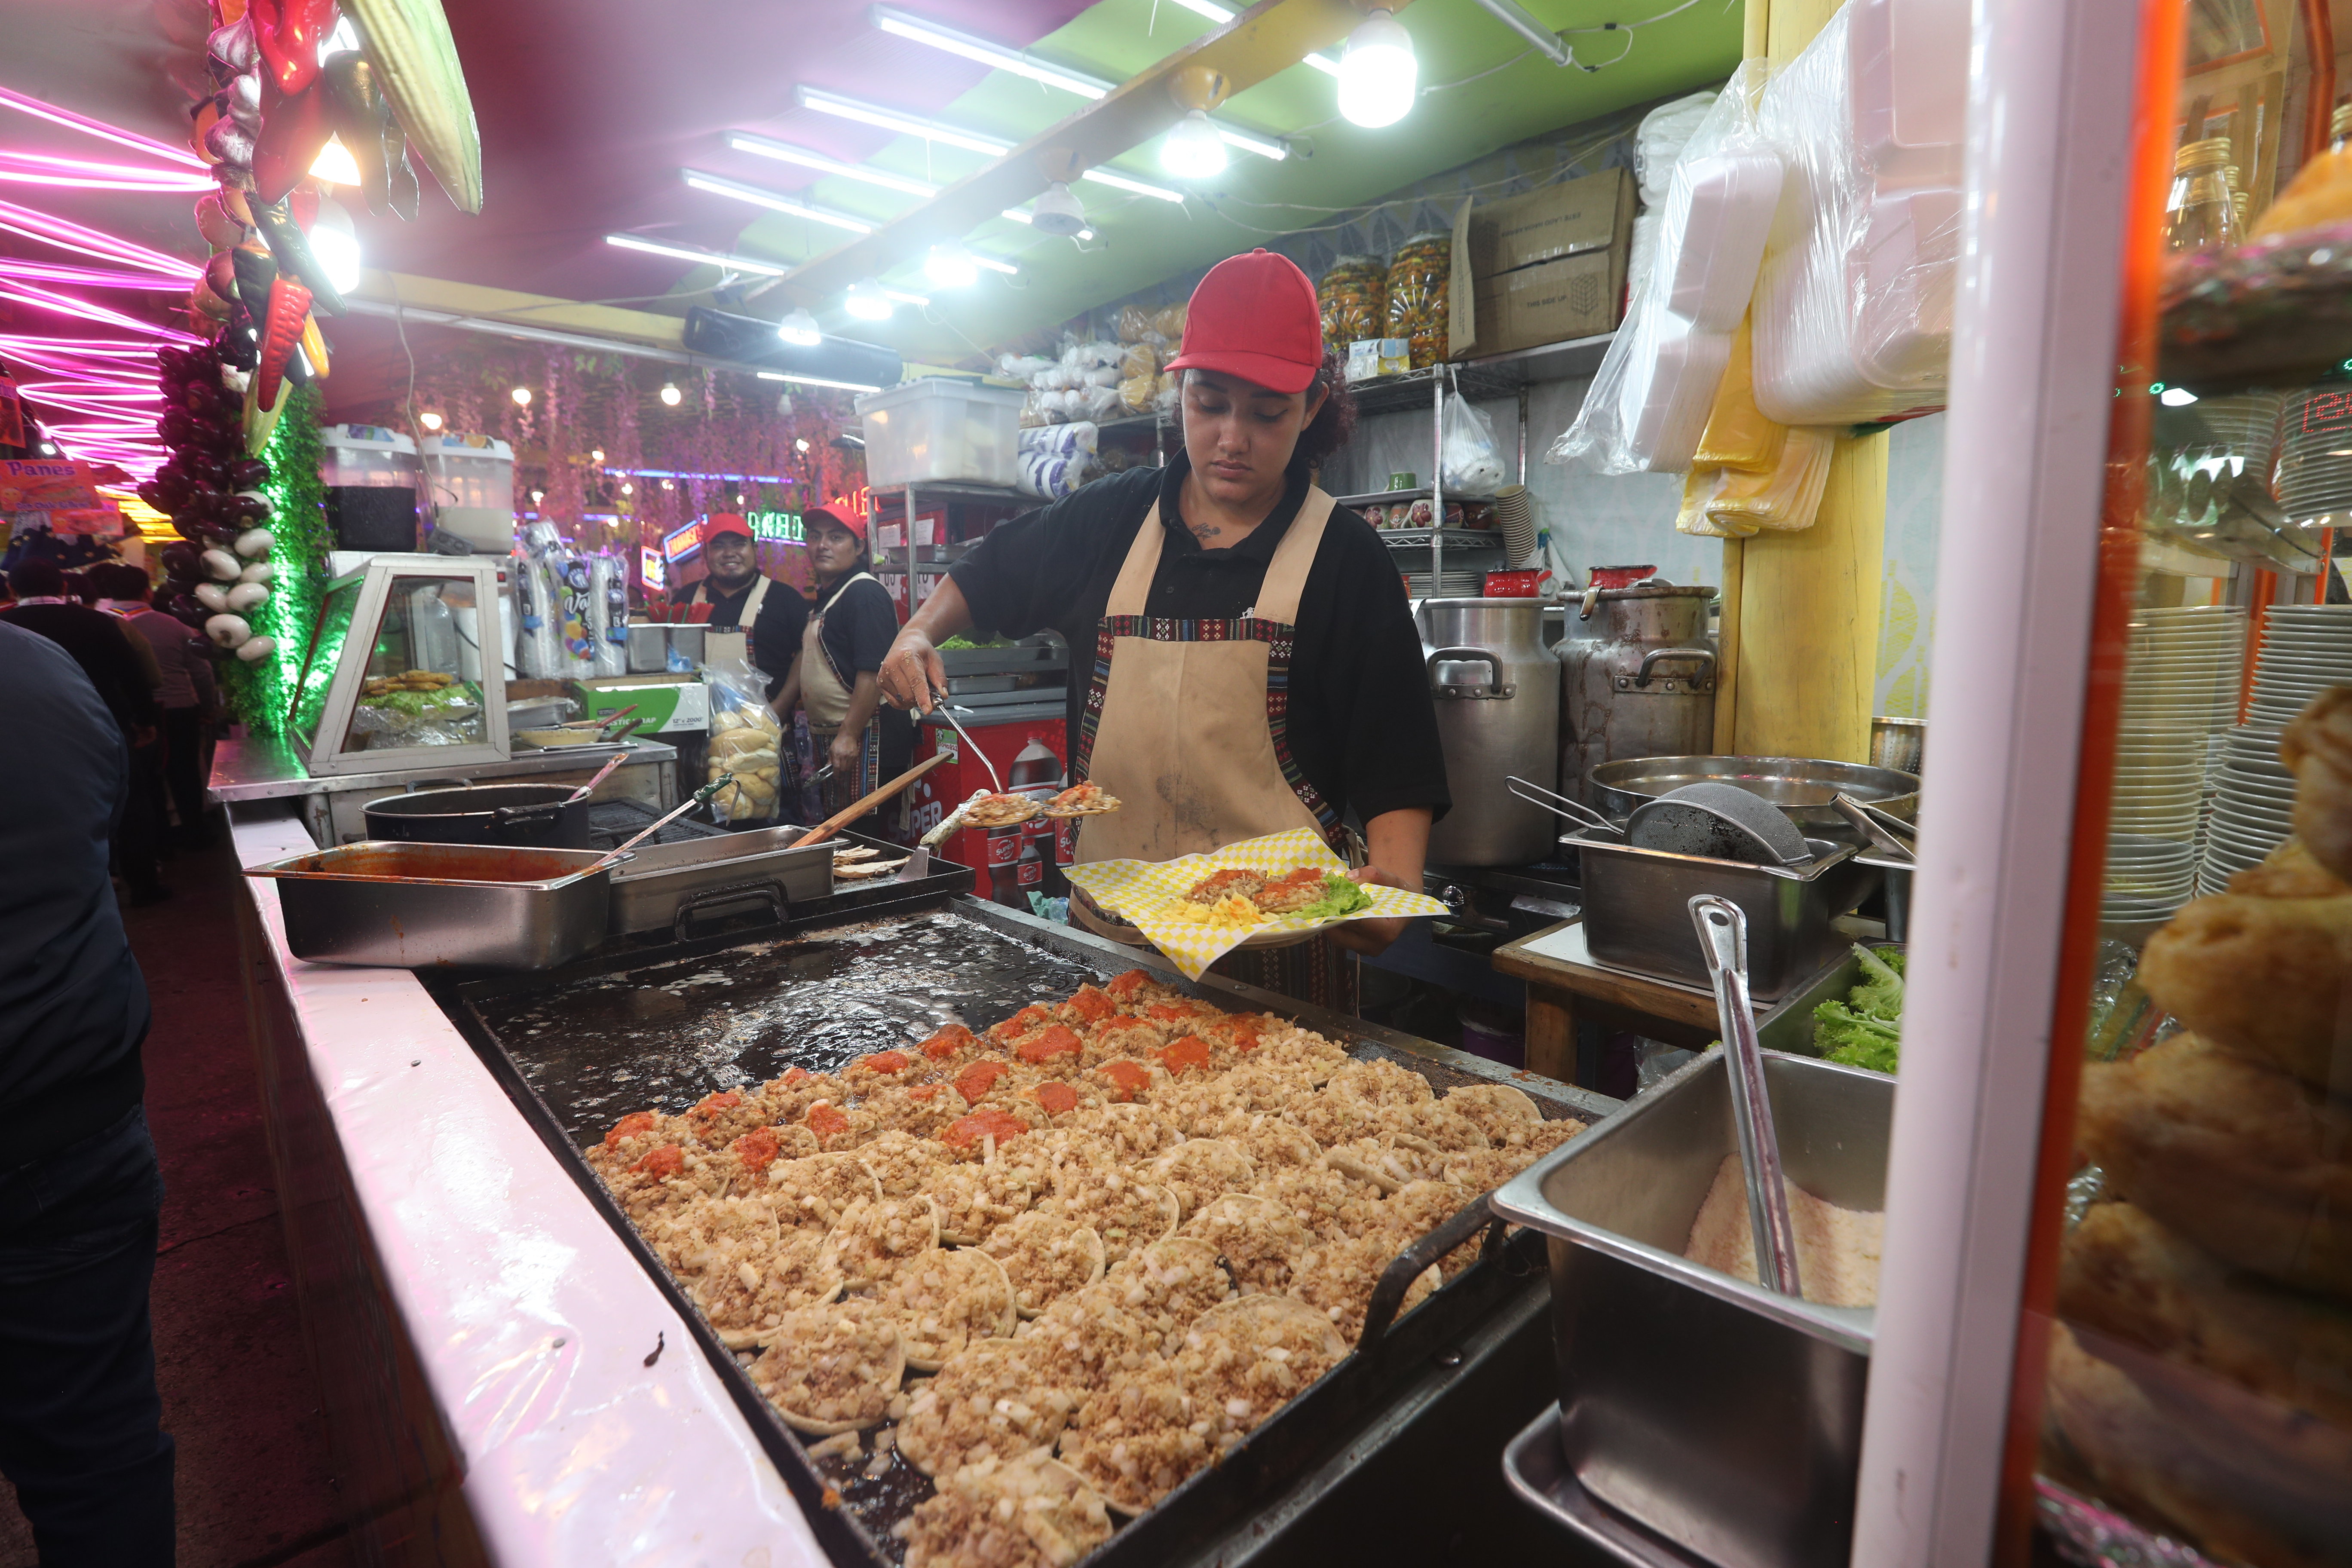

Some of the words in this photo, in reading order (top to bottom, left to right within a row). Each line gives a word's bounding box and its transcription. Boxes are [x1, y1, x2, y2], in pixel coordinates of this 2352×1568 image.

[6, 460, 76, 477] Panes
[996, 842, 1015, 856] SUPER
[1023, 867, 1037, 877] SUPER
